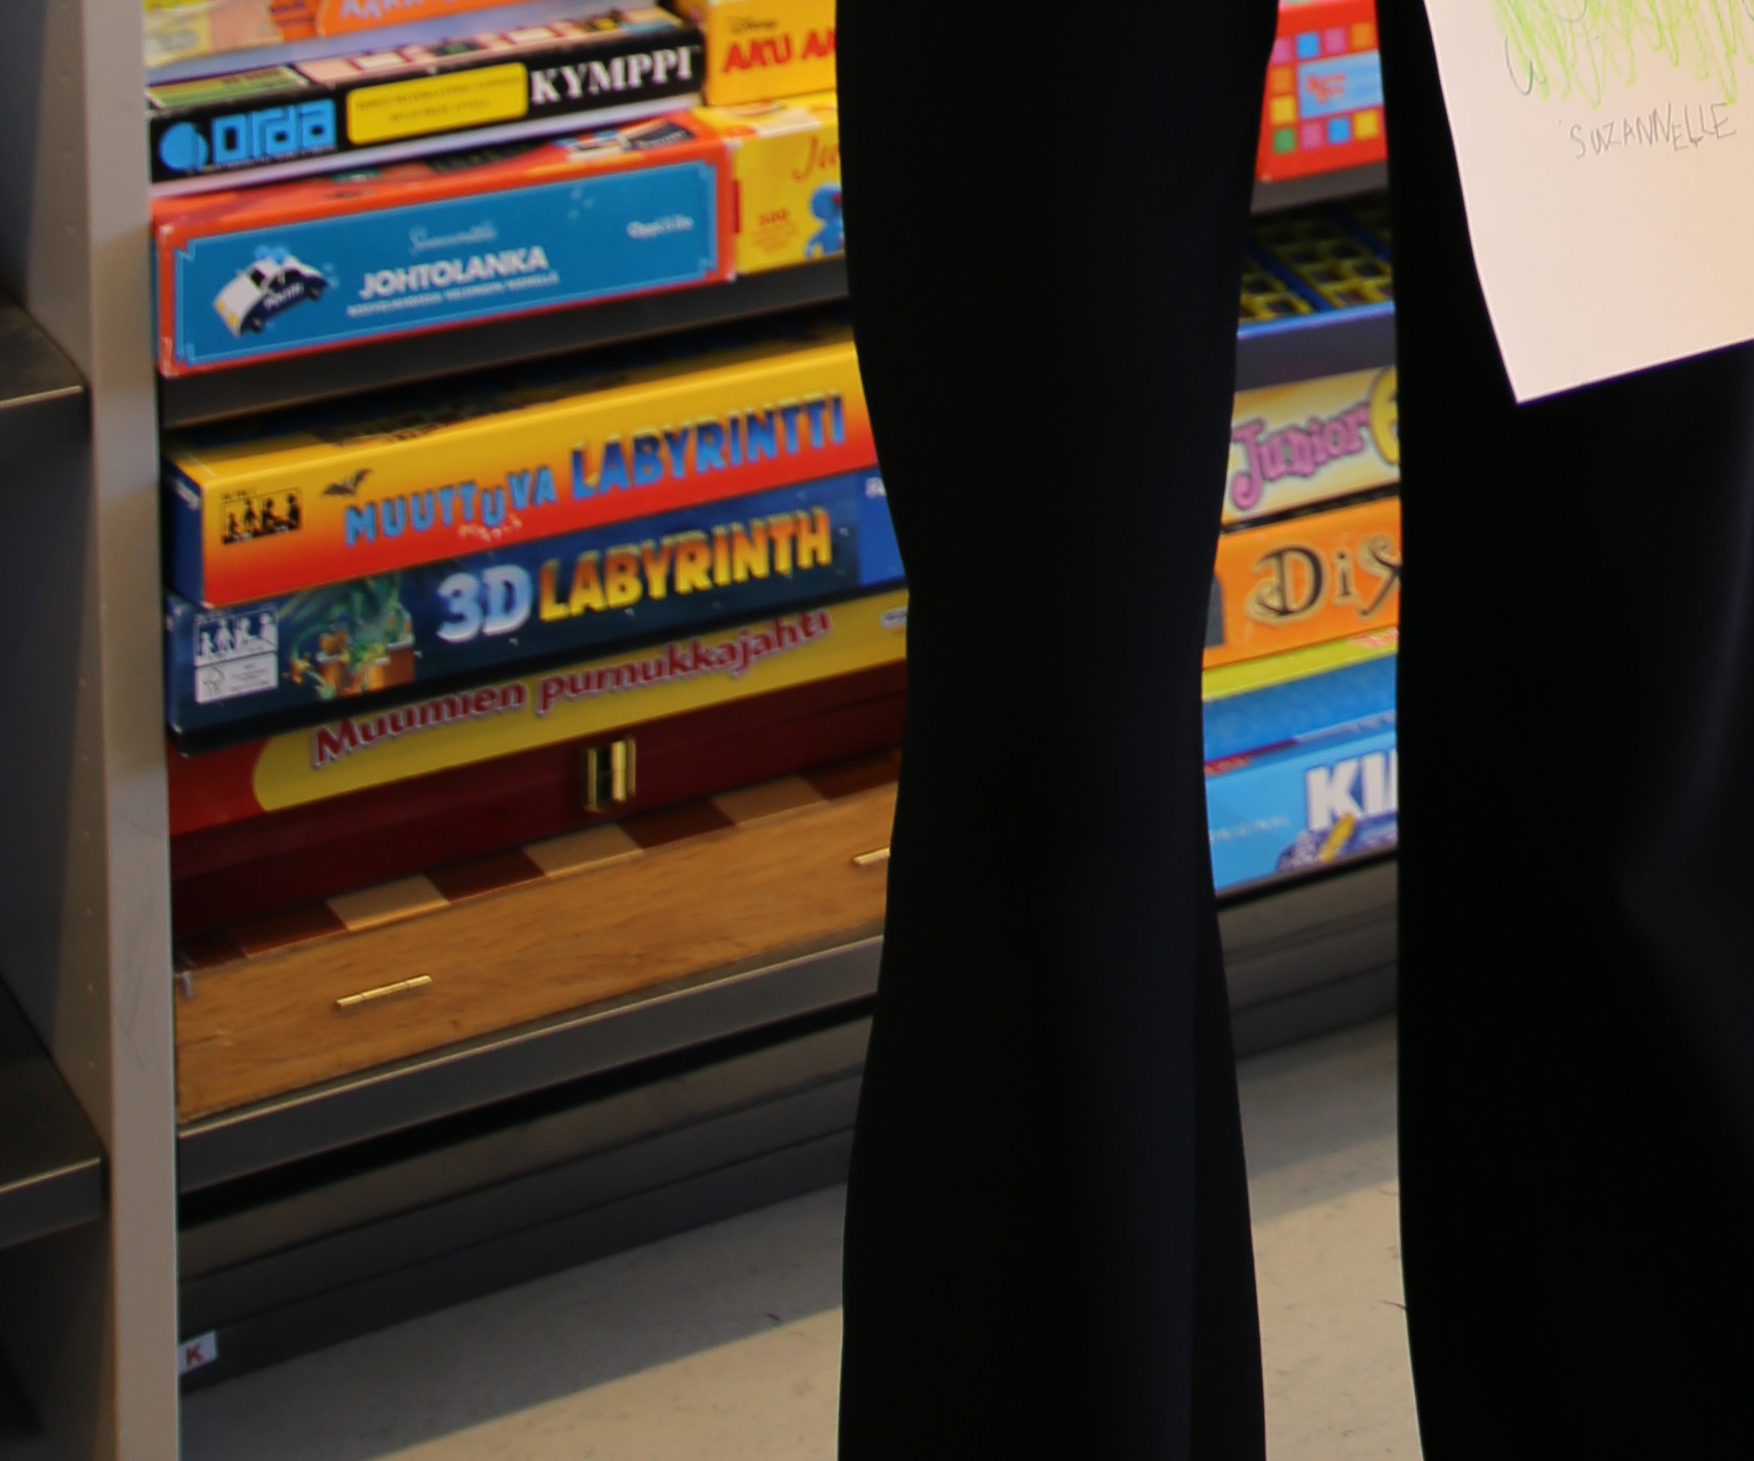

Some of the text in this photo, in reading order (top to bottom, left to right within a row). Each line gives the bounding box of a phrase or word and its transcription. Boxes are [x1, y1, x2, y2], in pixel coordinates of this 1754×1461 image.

[530, 44, 693, 105] KYMPPI
[722, 32, 793, 74] AKU
[1569, 101, 1738, 159] SUZANNELLE
[358, 245, 549, 300] JOHTOLANKA
[344, 389, 847, 547] MUUTTUVA LABYRINTTI
[1231, 398, 1371, 511] Junior
[436, 506, 833, 644] 3D LABYRINTH
[312, 608, 832, 770] Muumien purnukkajahti
